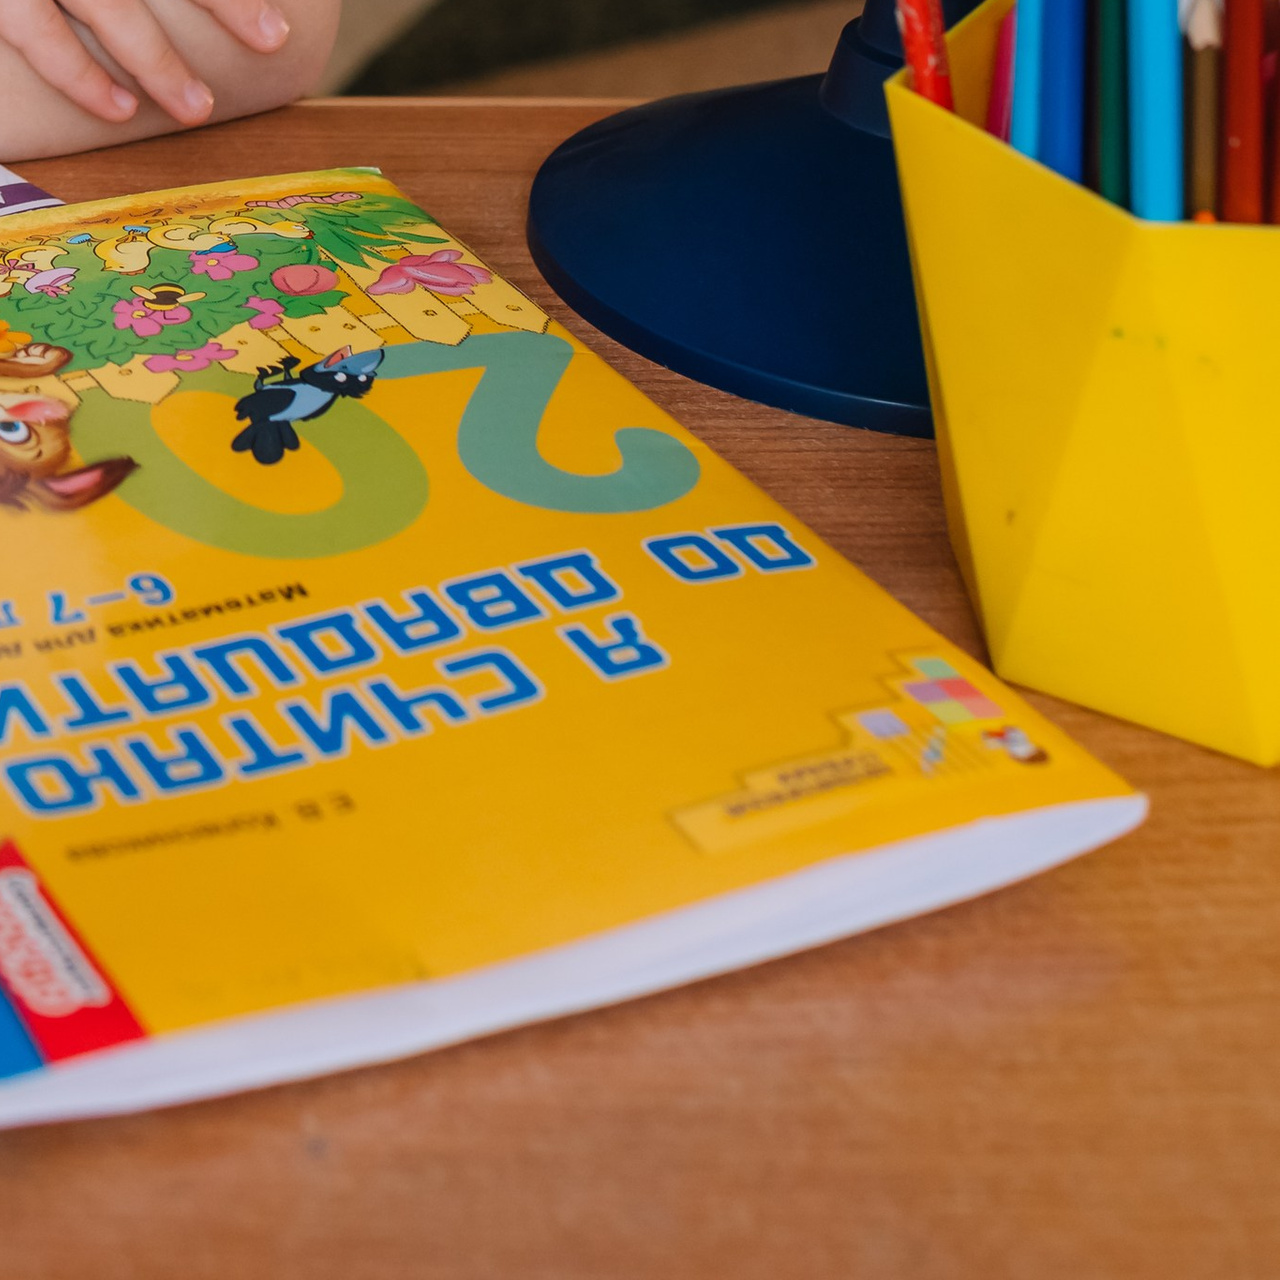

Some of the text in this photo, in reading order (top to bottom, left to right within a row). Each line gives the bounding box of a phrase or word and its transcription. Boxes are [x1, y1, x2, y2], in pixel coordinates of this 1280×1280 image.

[644, 522, 816, 583] ДО
[106, 581, 309, 638] Математика
[34, 627, 98, 654] для
[4, 614, 668, 812] Я СЧИТАЮ
